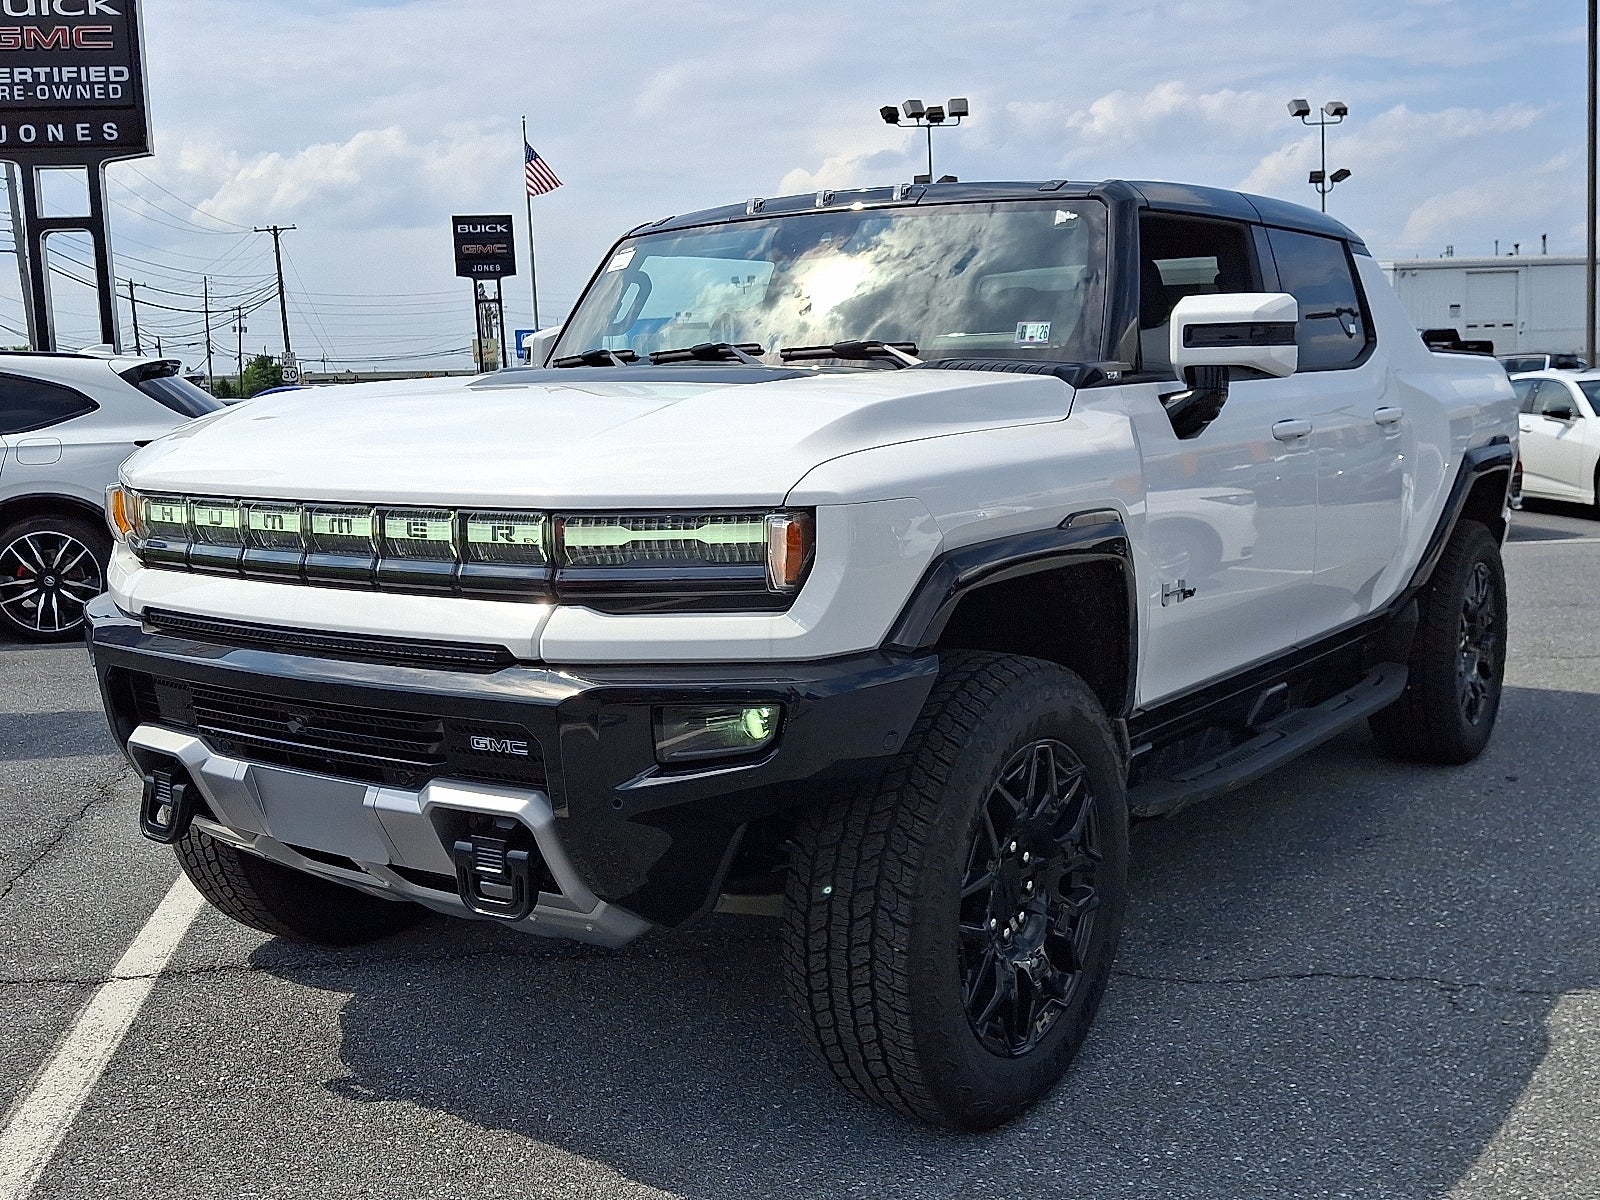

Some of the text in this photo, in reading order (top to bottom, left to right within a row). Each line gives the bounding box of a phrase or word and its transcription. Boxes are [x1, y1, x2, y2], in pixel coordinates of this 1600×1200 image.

[0, 25, 114, 50] GMC
[457, 224, 508, 233] BUICK
[462, 244, 507, 253] GMC
[472, 264, 501, 272] JONES
[284, 370, 297, 379] 30
[161, 506, 516, 543] HUMMER
[470, 735, 529, 756] GMC
